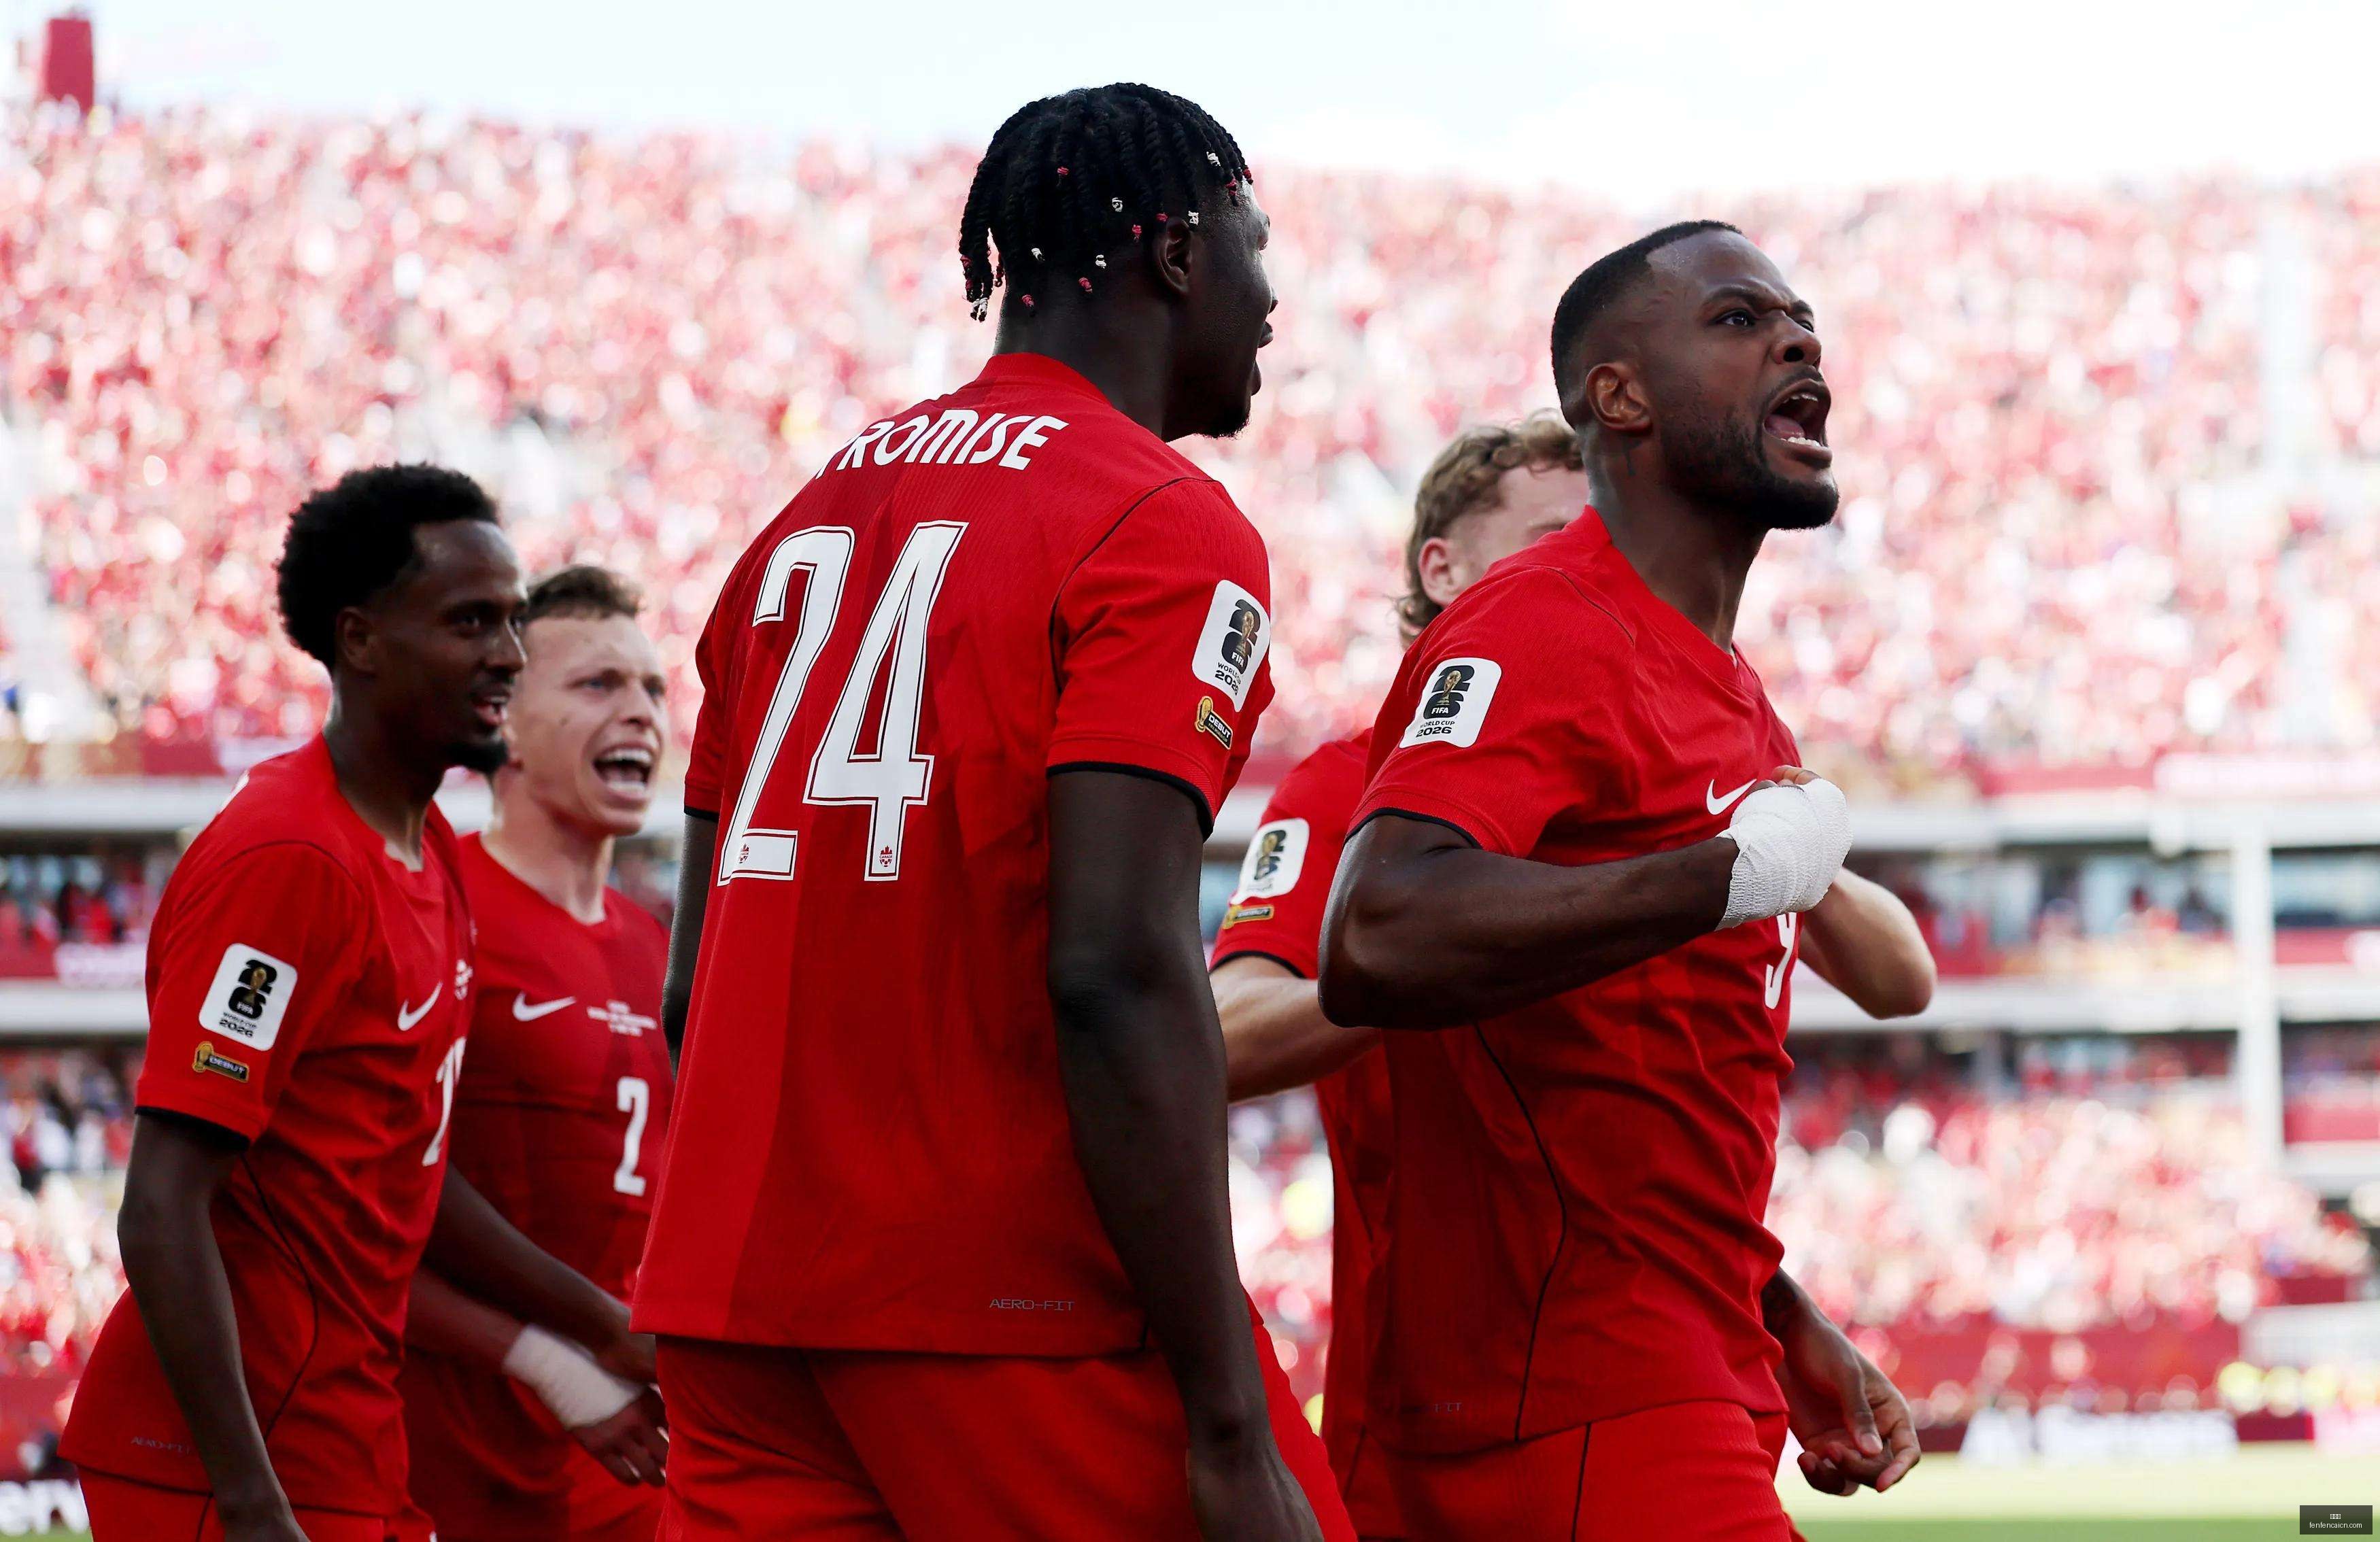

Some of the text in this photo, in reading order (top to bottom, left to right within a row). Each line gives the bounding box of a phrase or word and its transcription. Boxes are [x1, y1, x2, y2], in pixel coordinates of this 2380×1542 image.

[815, 409, 1070, 480] ROMISE
[1231, 651, 1244, 668] FIFA
[717, 520, 970, 887] 24
[1208, 714, 1231, 738] DEBUT
[1415, 726, 1452, 738] 2026
[219, 1019, 254, 1038] 2026
[422, 1037, 466, 1167] 1
[613, 1076, 649, 1197] 2
[989, 1298, 1075, 1311] AERO-FIT
